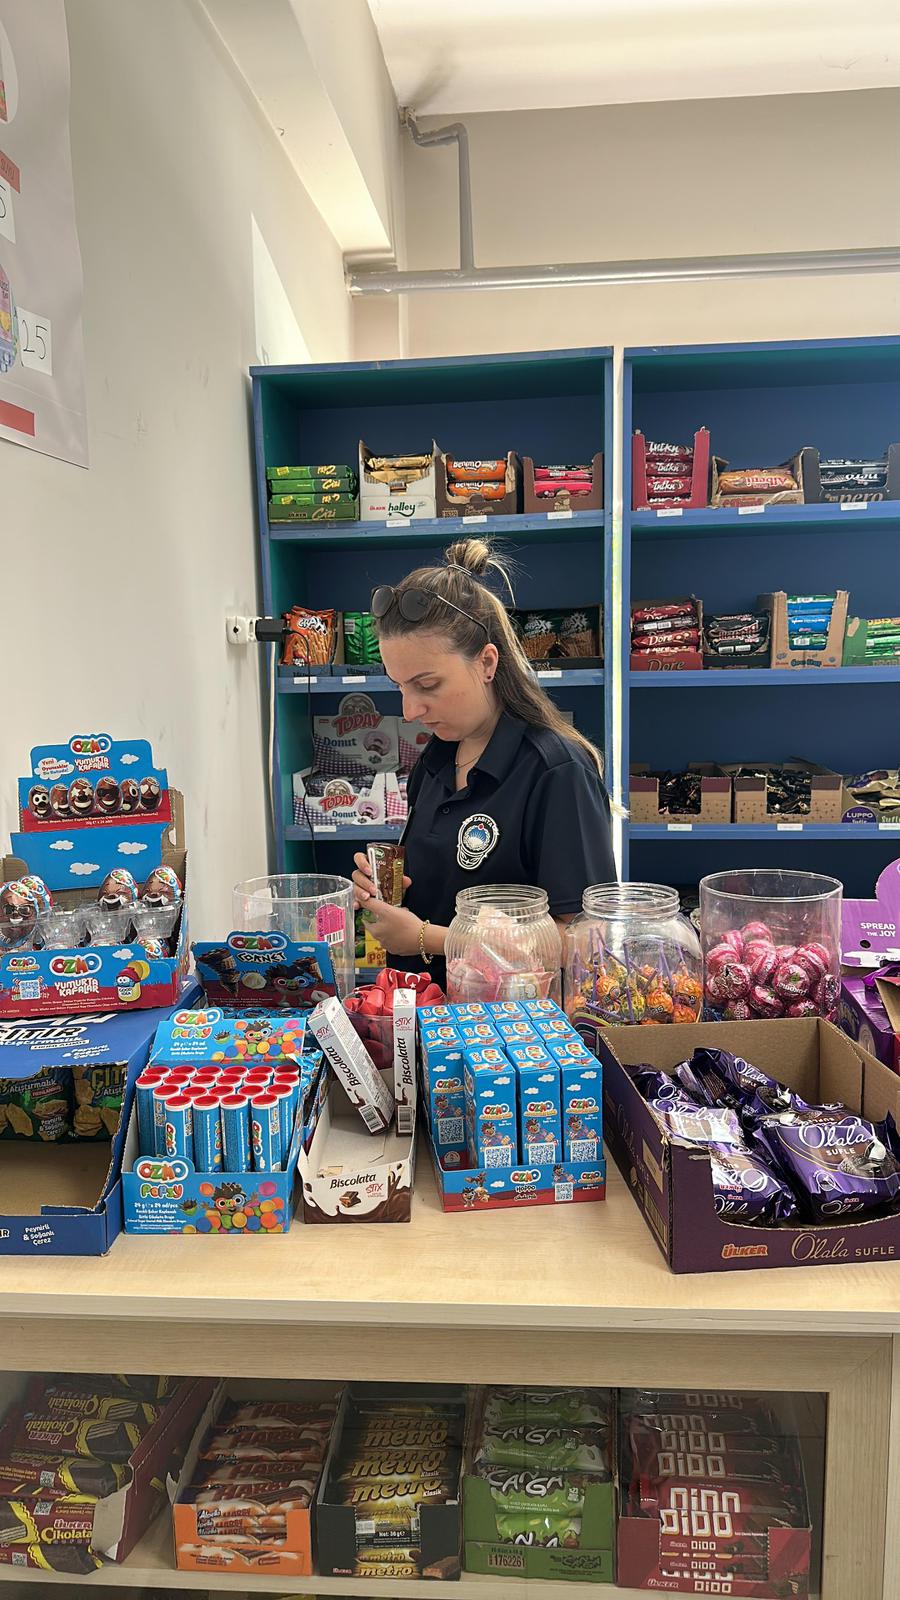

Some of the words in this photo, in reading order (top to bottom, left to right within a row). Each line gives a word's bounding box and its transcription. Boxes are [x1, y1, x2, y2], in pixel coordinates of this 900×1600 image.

[388, 502, 416, 517] halley
[333, 712, 384, 737] TODAY
[323, 737, 357, 747] Donut
[320, 795, 358, 811] TODAY
[231, 935, 286, 951] OZMO
[51, 956, 102, 975] OZMO
[54, 978, 98, 990] YUMURTA
[59, 985, 100, 997] KAFALAR
[174, 1010, 220, 1026] OZMO
[325, 1046, 361, 1087] Biscolata
[396, 1038, 413, 1086] Biscolata
[138, 1161, 188, 1182] OZMO
[512, 1171, 540, 1182] OZMO
[330, 1174, 376, 1189] Biscolata
[25, 1223, 50, 1233] Peynirli
[30, 1231, 54, 1239] Soğanlı
[33, 1238, 51, 1246] Çerez
[722, 1244, 768, 1258] ÜLKER
[855, 1246, 895, 1256] SUFLE
[352, 1481, 441, 1502] metro
[423, 1489, 442, 1498] Klasik
[360, 1565, 413, 1577] metro
